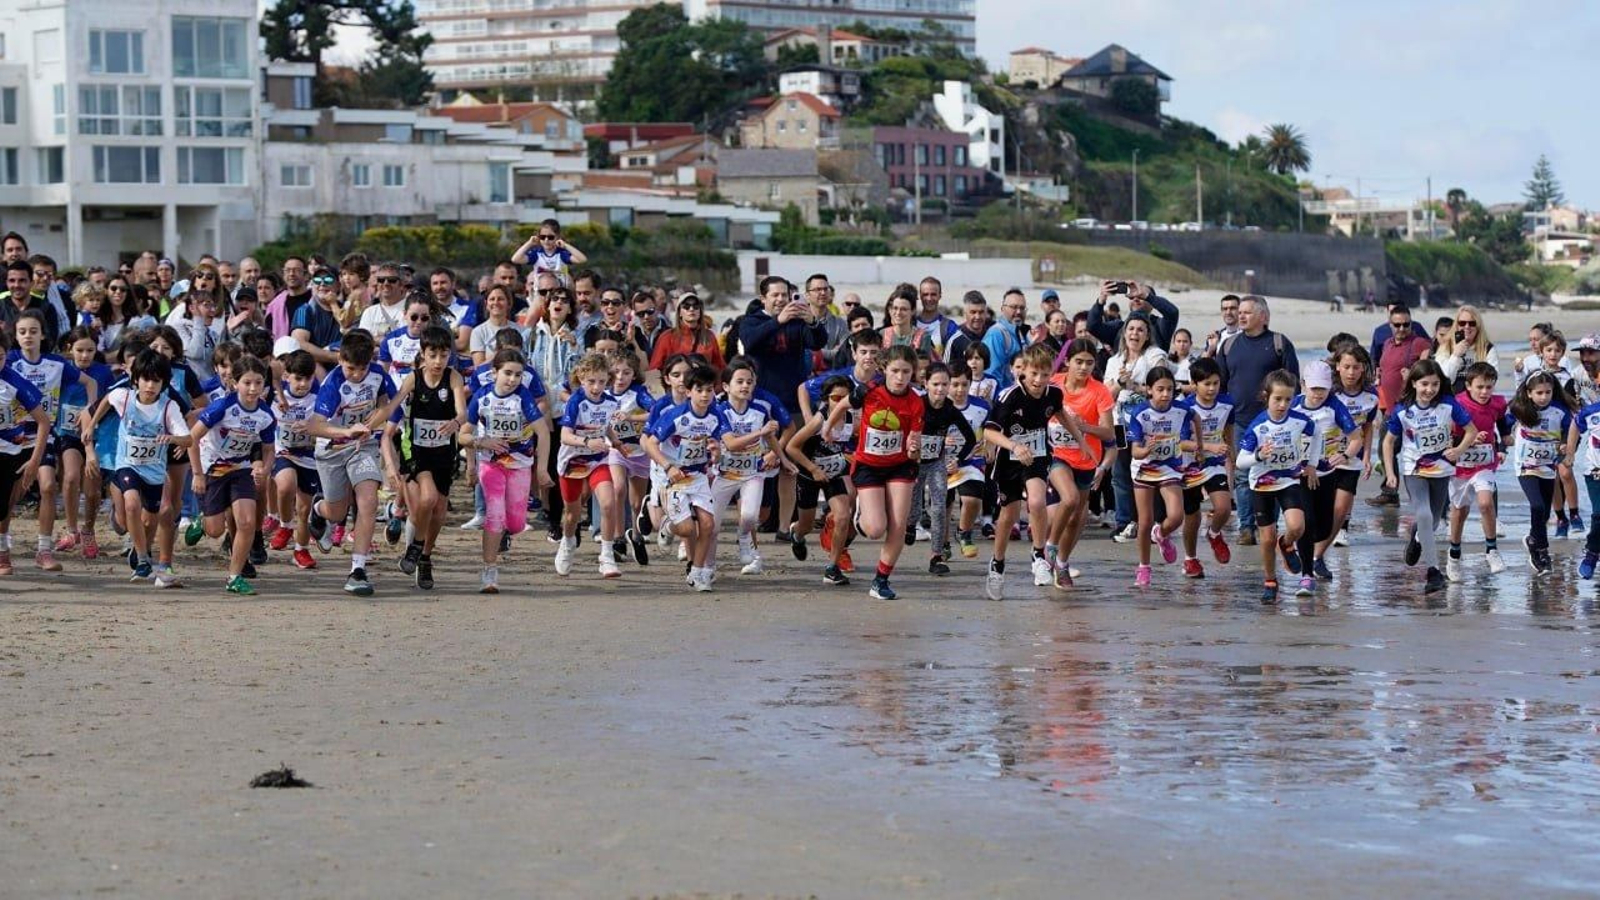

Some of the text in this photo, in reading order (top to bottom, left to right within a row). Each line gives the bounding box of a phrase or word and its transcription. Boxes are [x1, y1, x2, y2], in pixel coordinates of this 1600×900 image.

[491, 419, 518, 431] 260
[873, 436, 898, 450] 249
[1421, 432, 1446, 447] 259
[130, 446, 157, 459] 226
[1271, 451, 1296, 464] 264
[1462, 451, 1488, 463] 227
[1527, 447, 1550, 460] 262
[727, 458, 752, 469] 220
